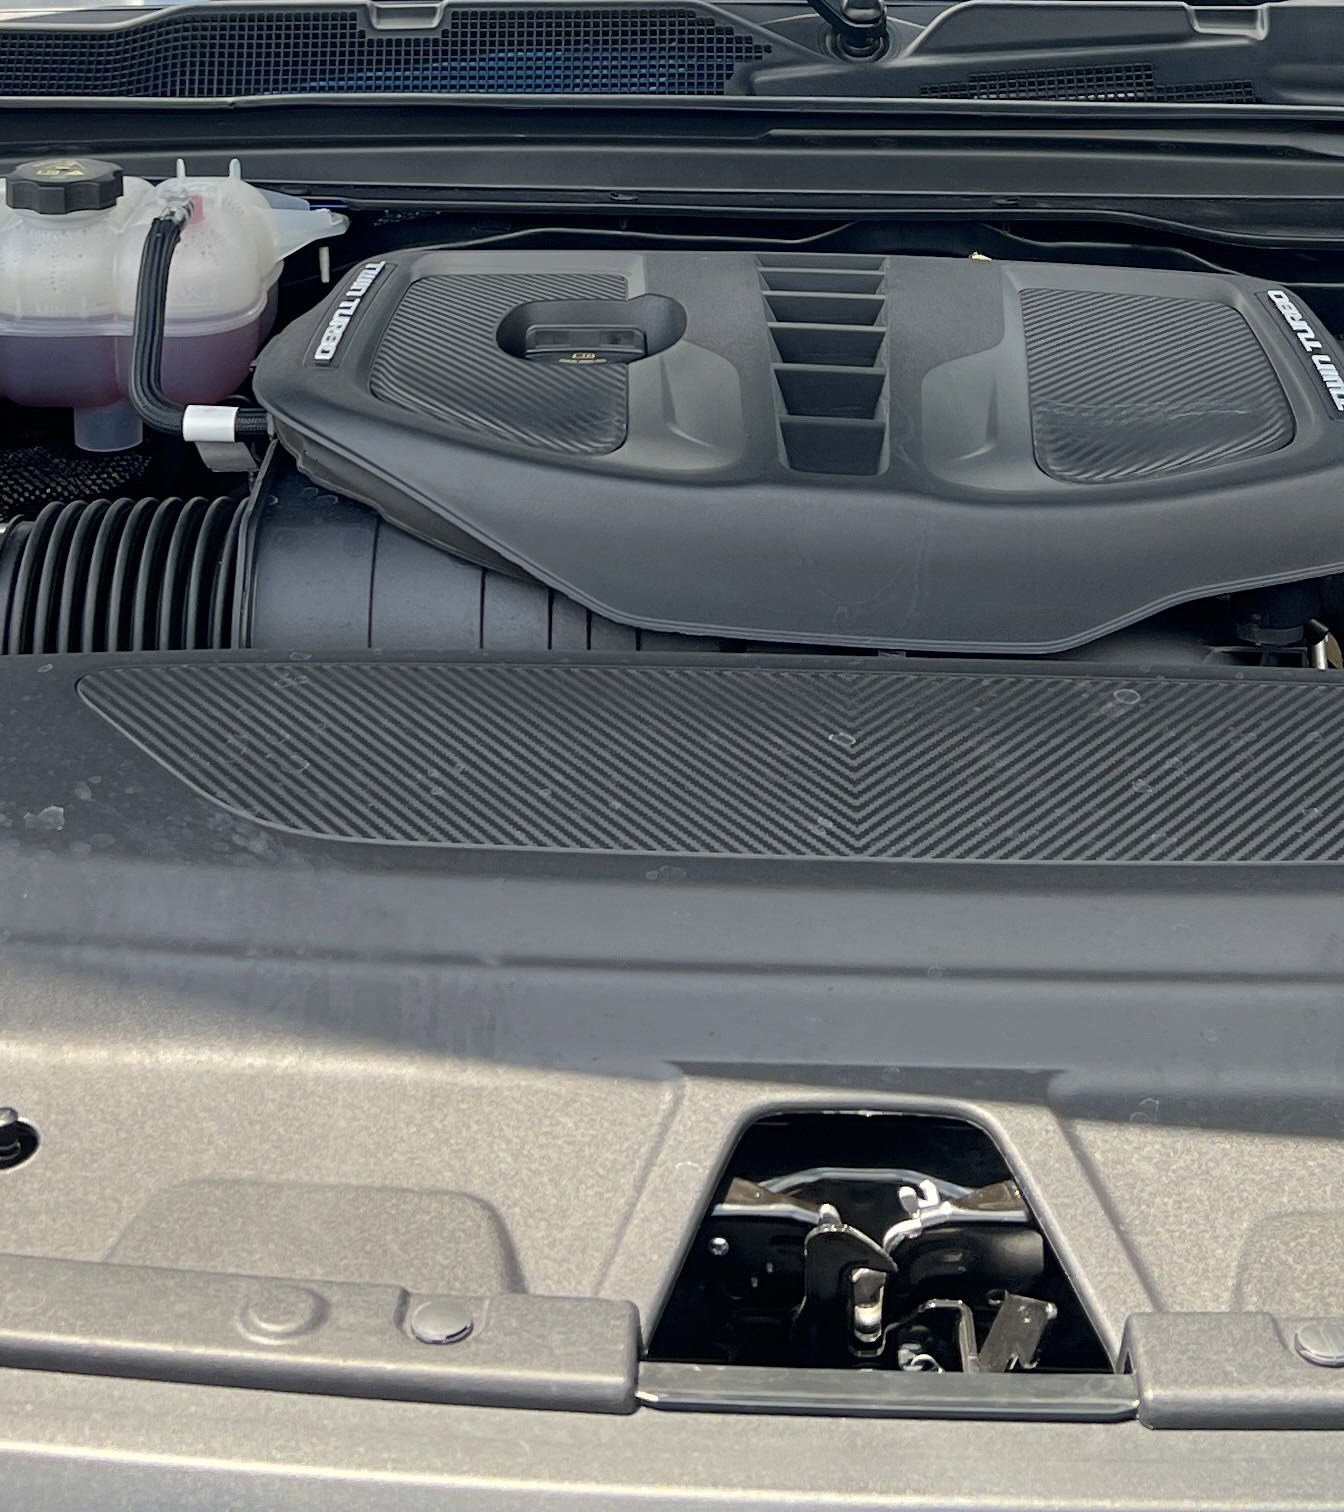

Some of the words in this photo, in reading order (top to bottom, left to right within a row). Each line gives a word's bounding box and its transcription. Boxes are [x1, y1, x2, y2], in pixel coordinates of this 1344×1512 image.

[345, 260, 386, 297] TWIN
[314, 297, 361, 360] TURBO
[1267, 290, 1323, 352] TURBO
